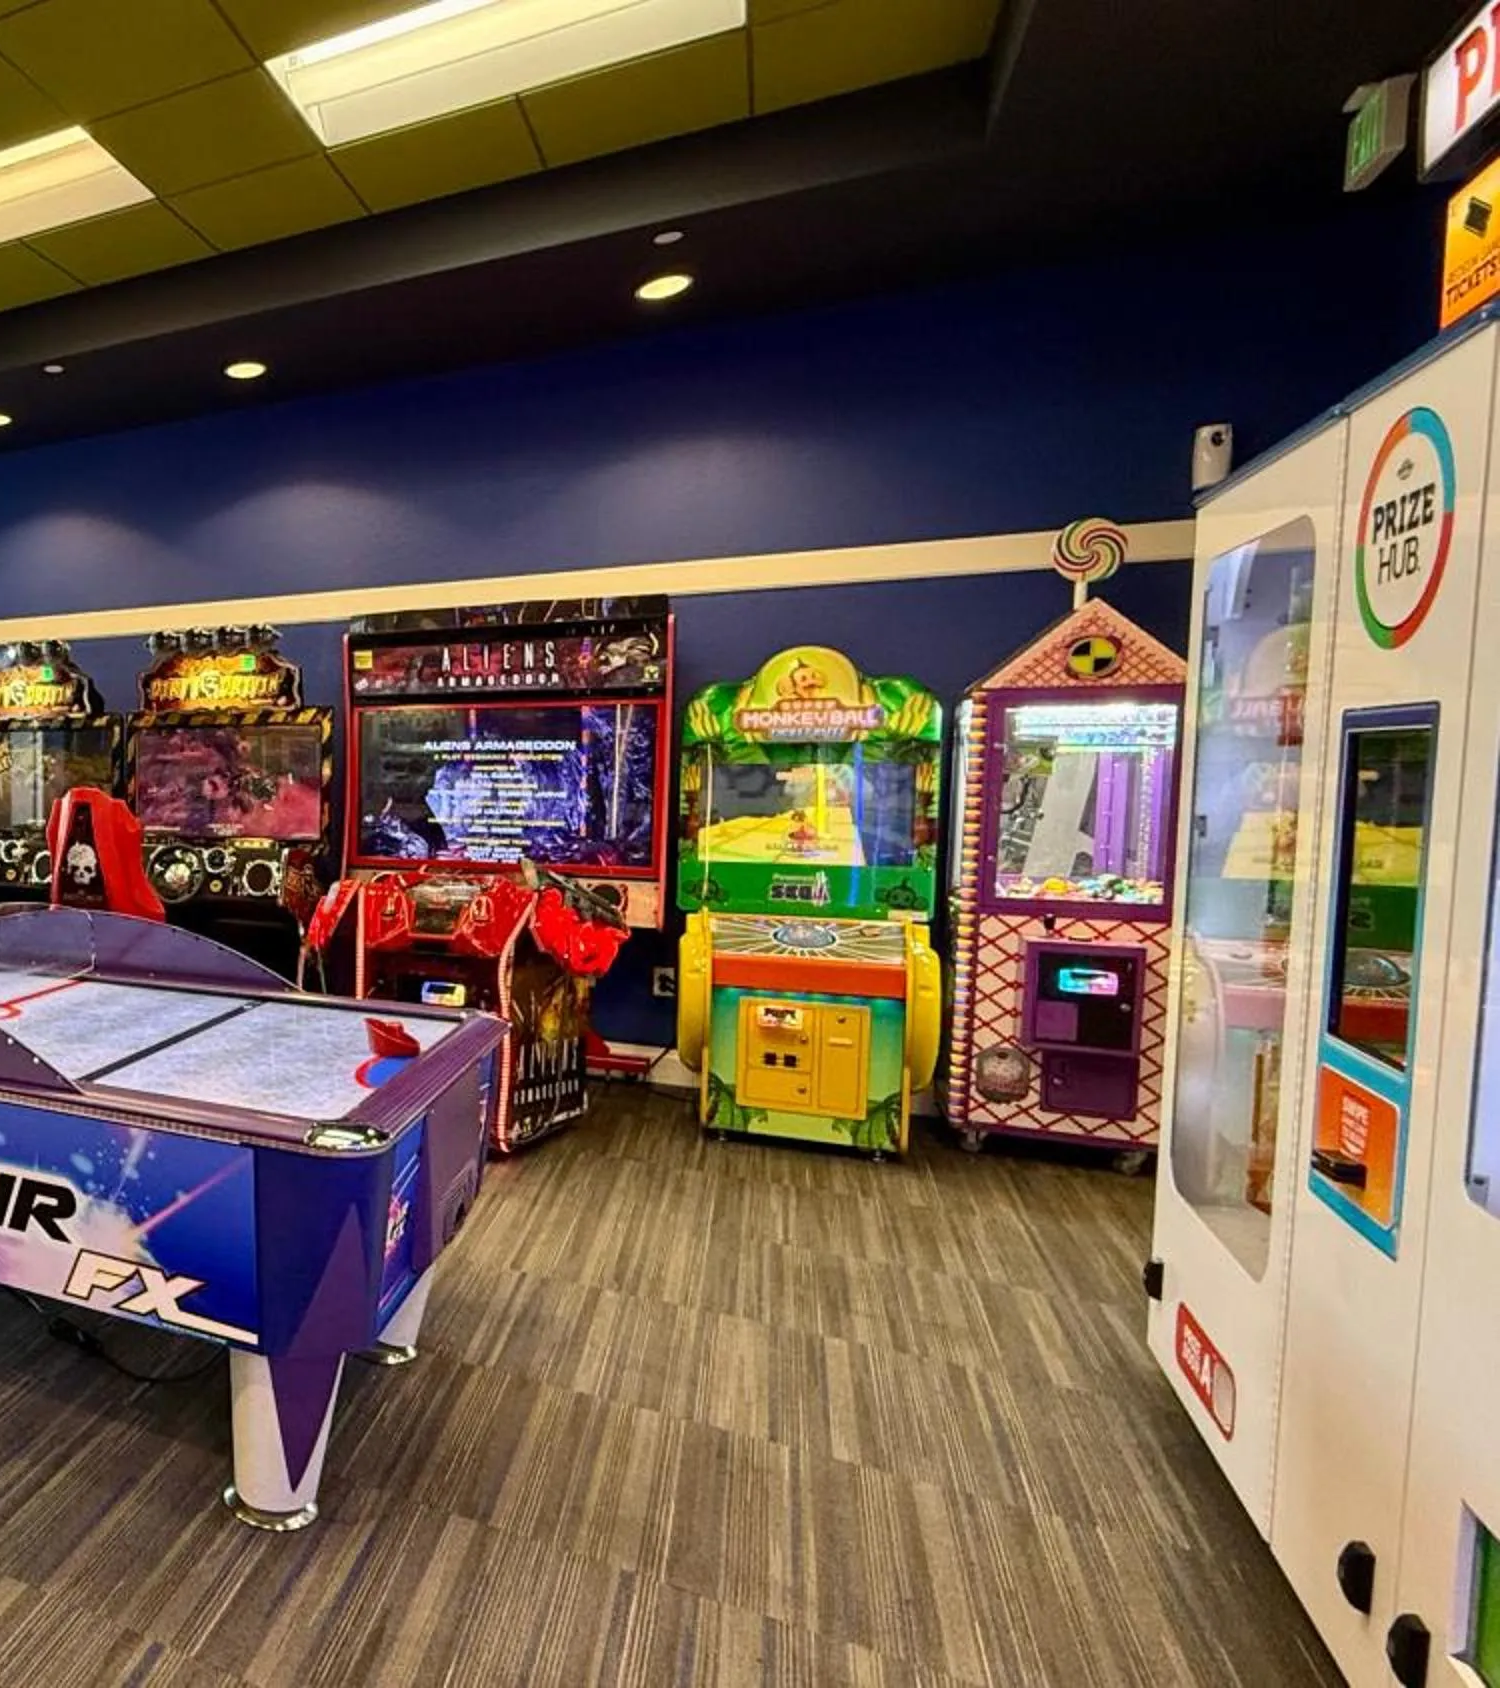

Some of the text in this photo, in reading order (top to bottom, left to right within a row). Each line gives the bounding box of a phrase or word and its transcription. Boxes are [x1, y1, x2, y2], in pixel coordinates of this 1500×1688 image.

[1372, 482, 1435, 544] PRIZE
[441, 640, 556, 672] ALIENS
[742, 709, 879, 729] MONKEY BALL
[422, 740, 577, 751] ALIENS ARMAGEDDON
[62, 1248, 257, 1343] FX
